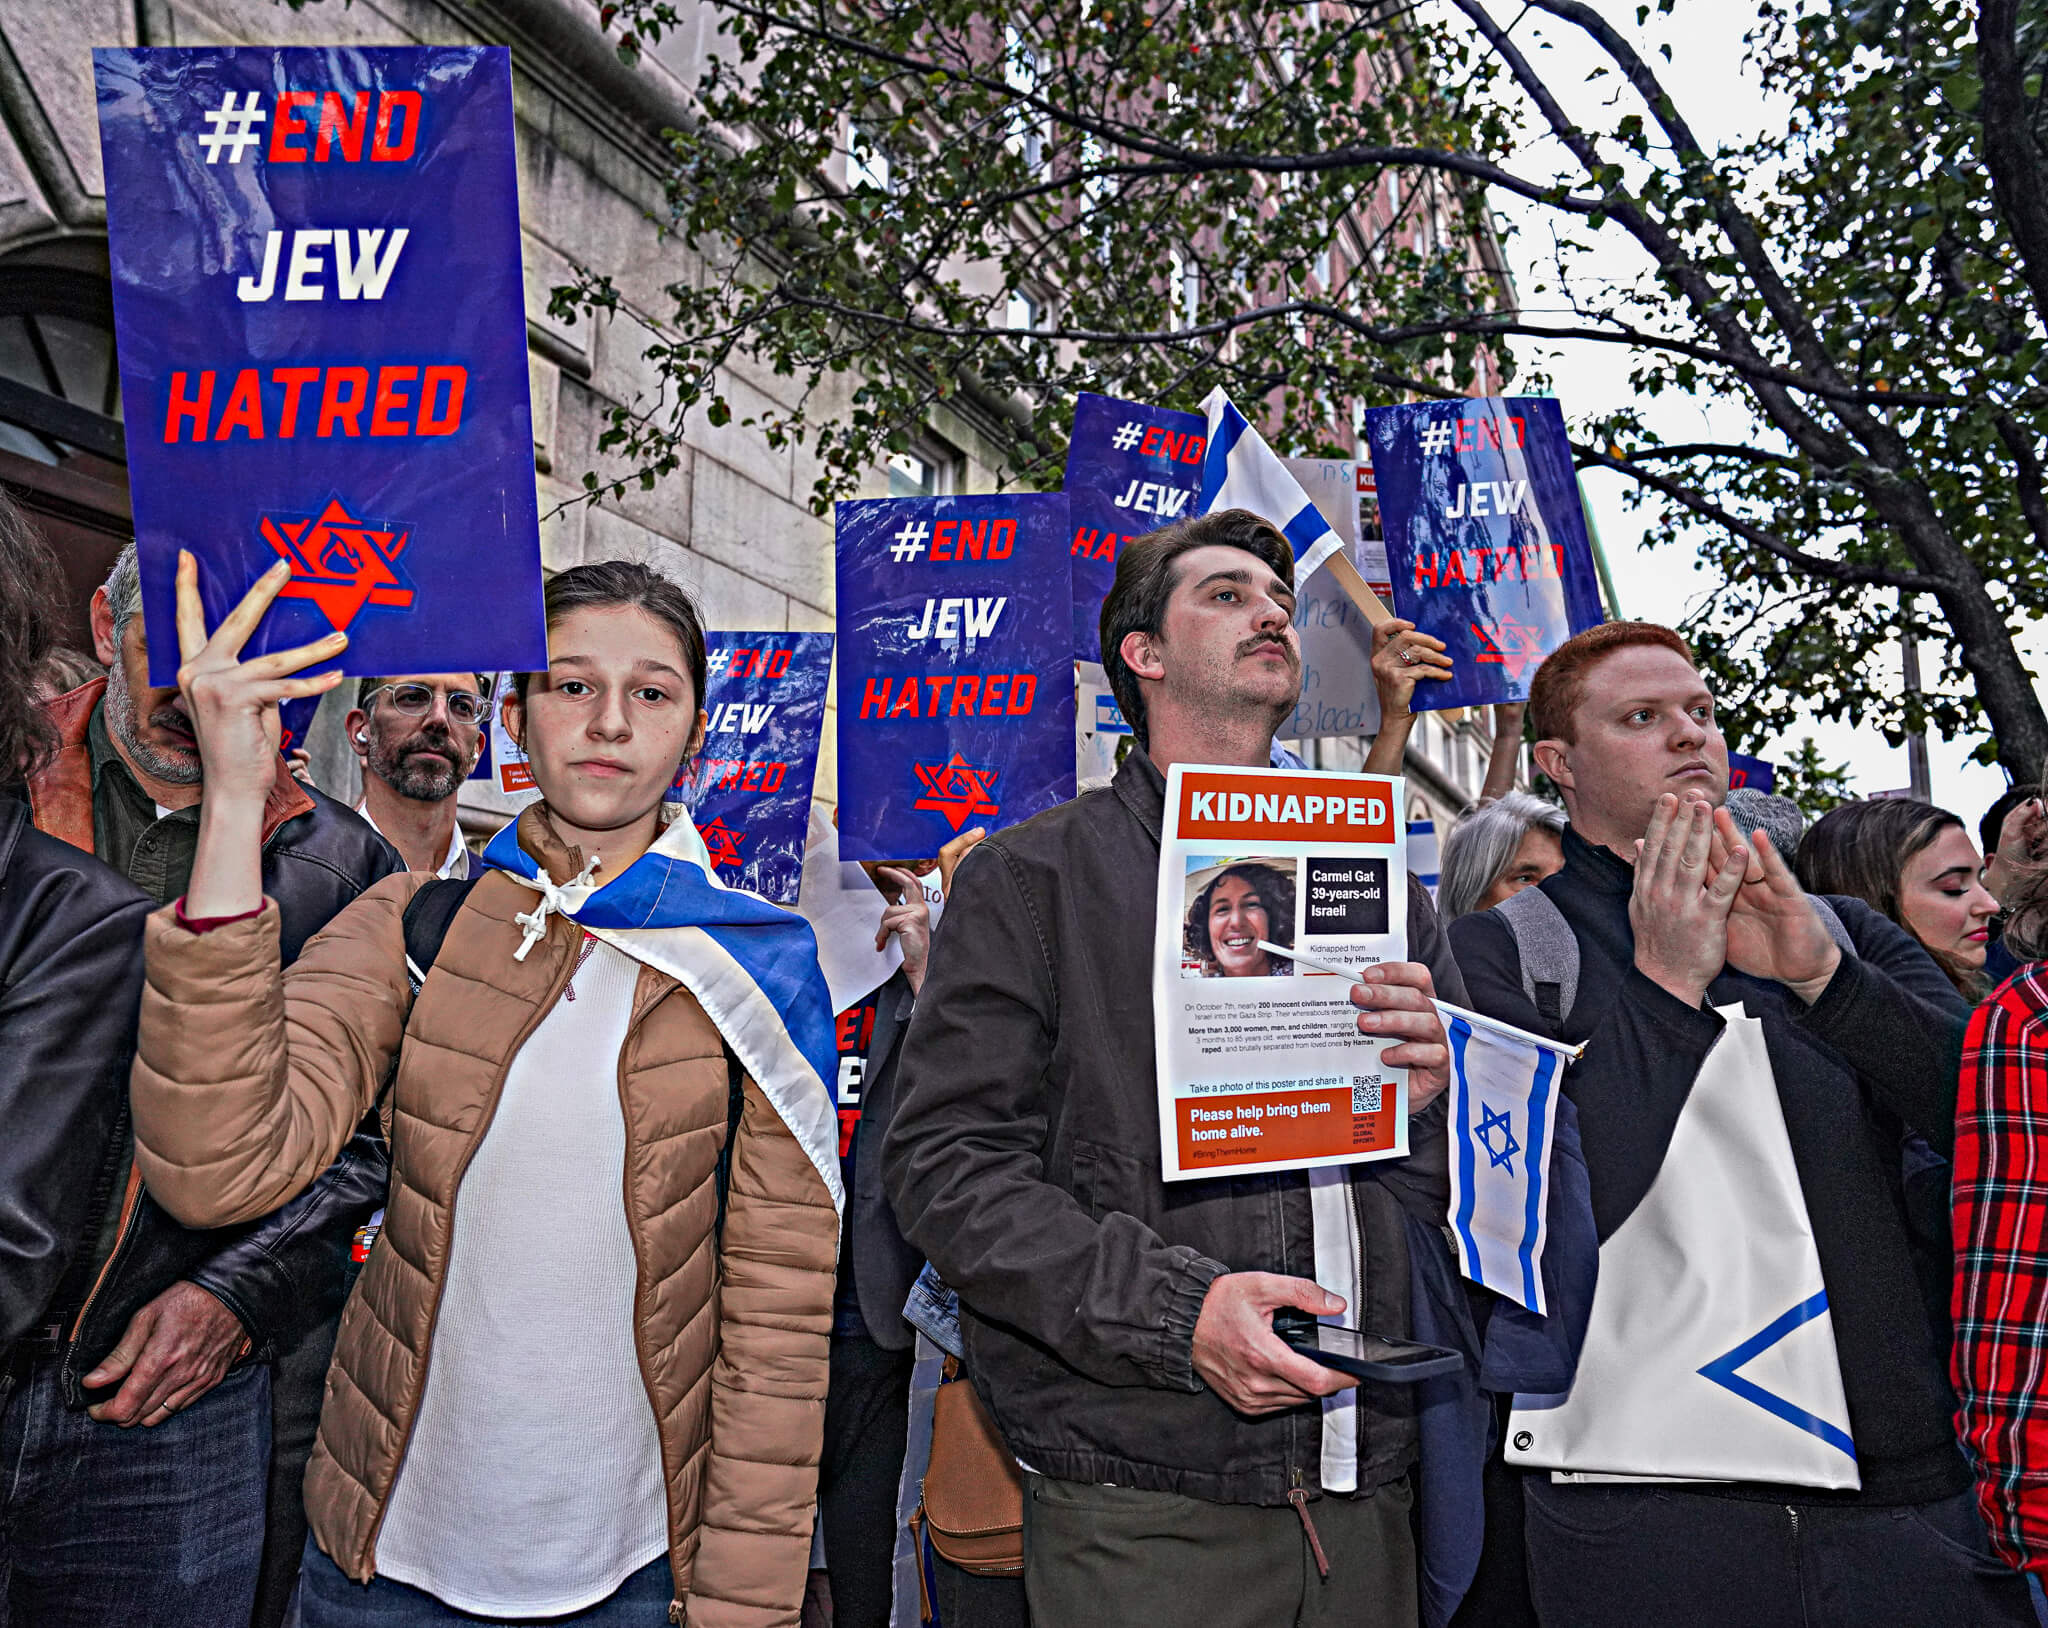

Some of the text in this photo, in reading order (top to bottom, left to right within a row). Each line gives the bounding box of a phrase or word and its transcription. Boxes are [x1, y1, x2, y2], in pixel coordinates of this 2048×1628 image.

[198, 90, 423, 164] #END
[237, 228, 410, 302] JEW
[164, 365, 469, 443] HATRED
[1112, 421, 1208, 465] #END
[1419, 416, 1526, 456] #END
[1114, 479, 1192, 518] JEW
[1445, 479, 1528, 519] JEW
[890, 518, 1018, 563] #END
[1413, 543, 1565, 591] HATRED
[907, 596, 1008, 640] JEW
[706, 648, 794, 679] #END
[859, 673, 1038, 720] HATRED
[706, 703, 777, 734] JEW
[668, 758, 788, 793] ATRED
[1191, 791, 1387, 826] KIDNAPPED
[1312, 869, 1375, 882] Carmel Gat
[1311, 887, 1381, 902] 39-years-old
[1311, 904, 1347, 917] Israeli
[1310, 945, 1349, 953] Kidnapped
[1344, 956, 1353, 964] by
[1355, 955, 1381, 963] Hamas
[1185, 1003, 1195, 1012] On
[1196, 1003, 1223, 1011] October
[1272, 1000, 1300, 1008] innocent
[1188, 1027, 1206, 1035] More
[1207, 1026, 1222, 1034] than
[1224, 1025, 1242, 1034] 3,000
[1243, 1025, 1270, 1033] women,
[1288, 1023, 1300, 1031] and
[1343, 1040, 1352, 1048] by
[1190, 1075, 1344, 1094] Take a photo of this poster and share it
[1190, 1101, 1331, 1123] Please help bring them
[1191, 1124, 1264, 1142] home alive.
